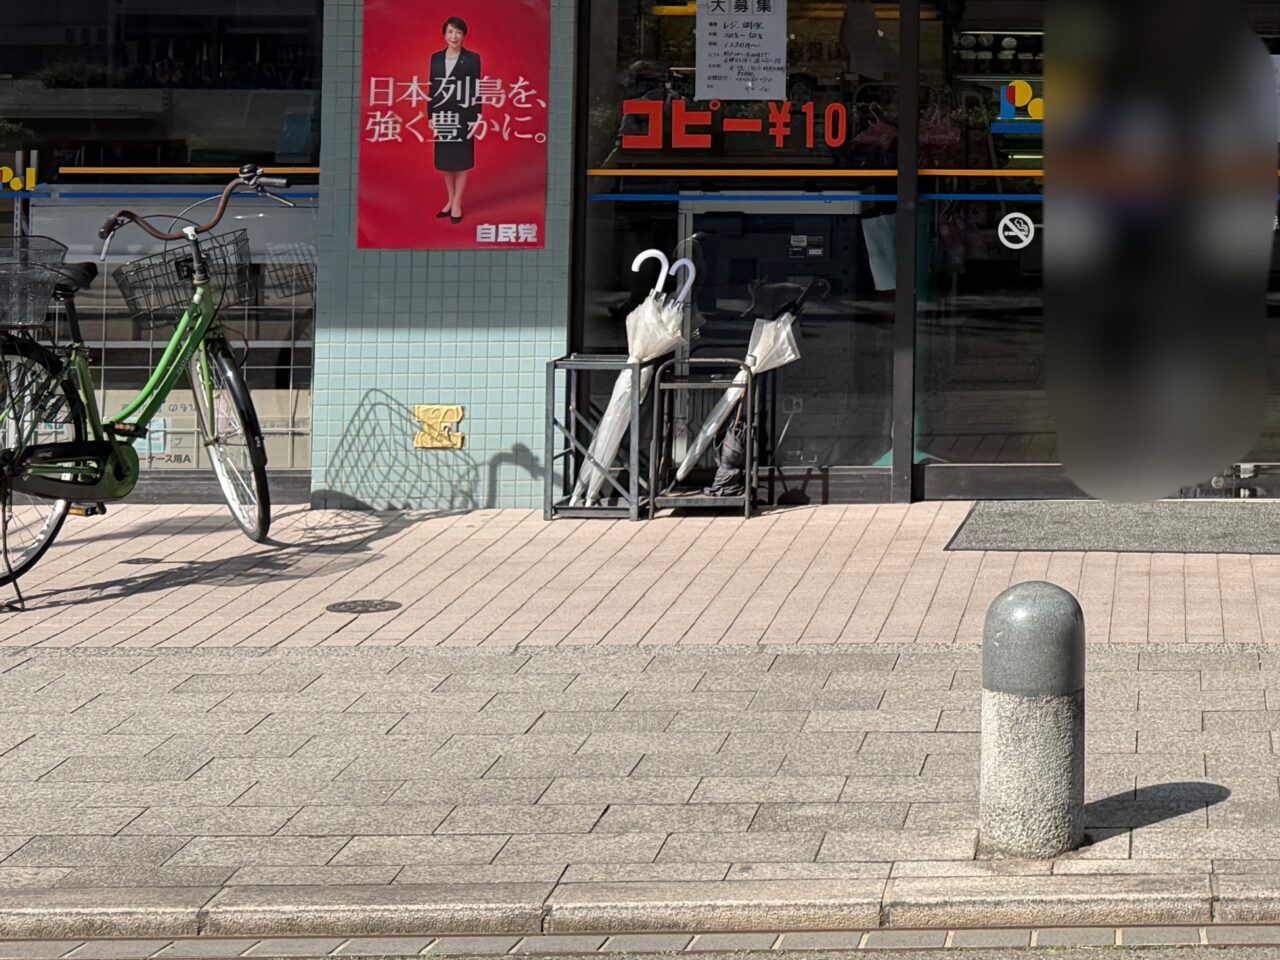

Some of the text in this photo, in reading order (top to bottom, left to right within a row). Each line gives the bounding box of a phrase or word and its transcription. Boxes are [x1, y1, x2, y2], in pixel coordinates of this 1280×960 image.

[368, 75, 547, 109] 日本列島を、
[365, 110, 547, 144] 強く豊かに。
[476, 223, 538, 243] 自民党
